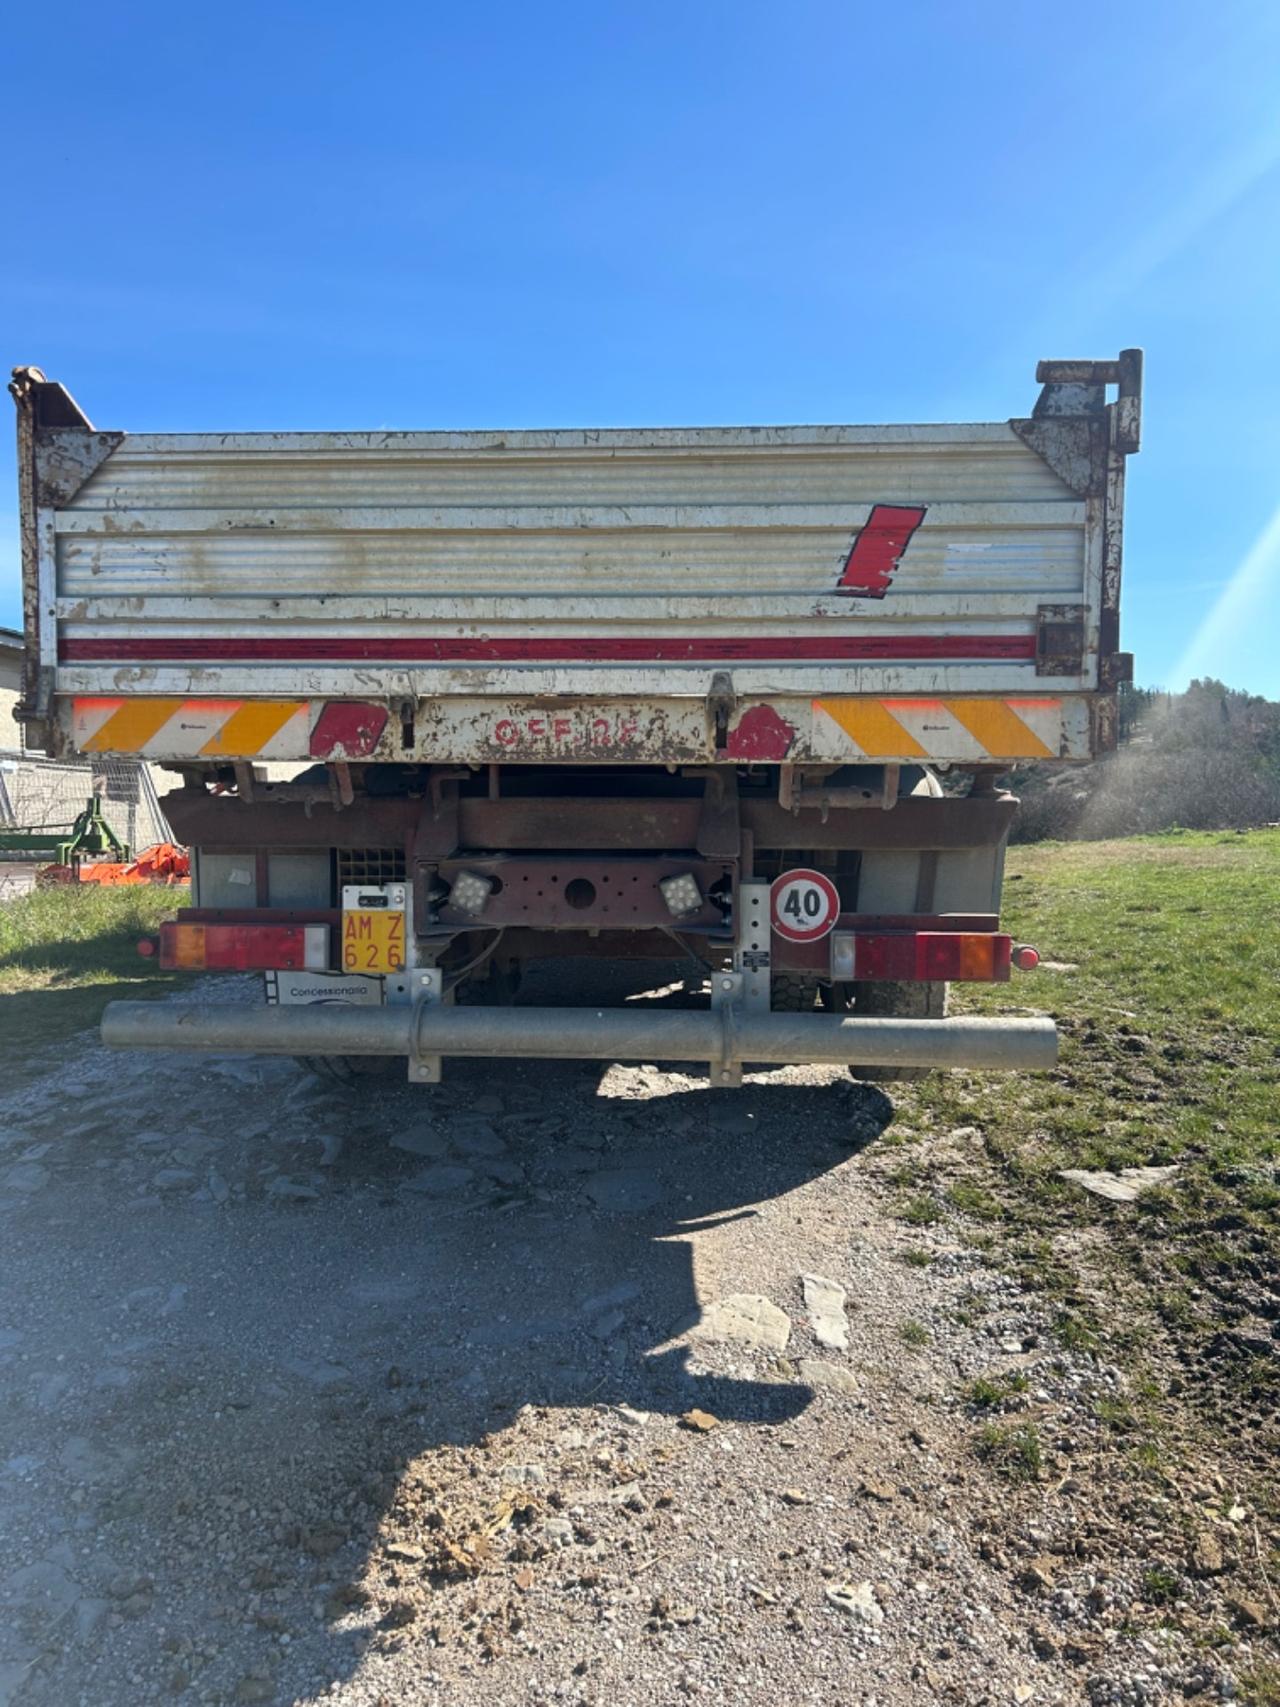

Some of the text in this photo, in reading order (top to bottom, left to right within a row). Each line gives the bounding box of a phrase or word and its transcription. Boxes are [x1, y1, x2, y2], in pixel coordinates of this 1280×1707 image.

[784, 888, 821, 917] 40
[345, 916, 401, 940] AM Z
[344, 944, 401, 968] 626
